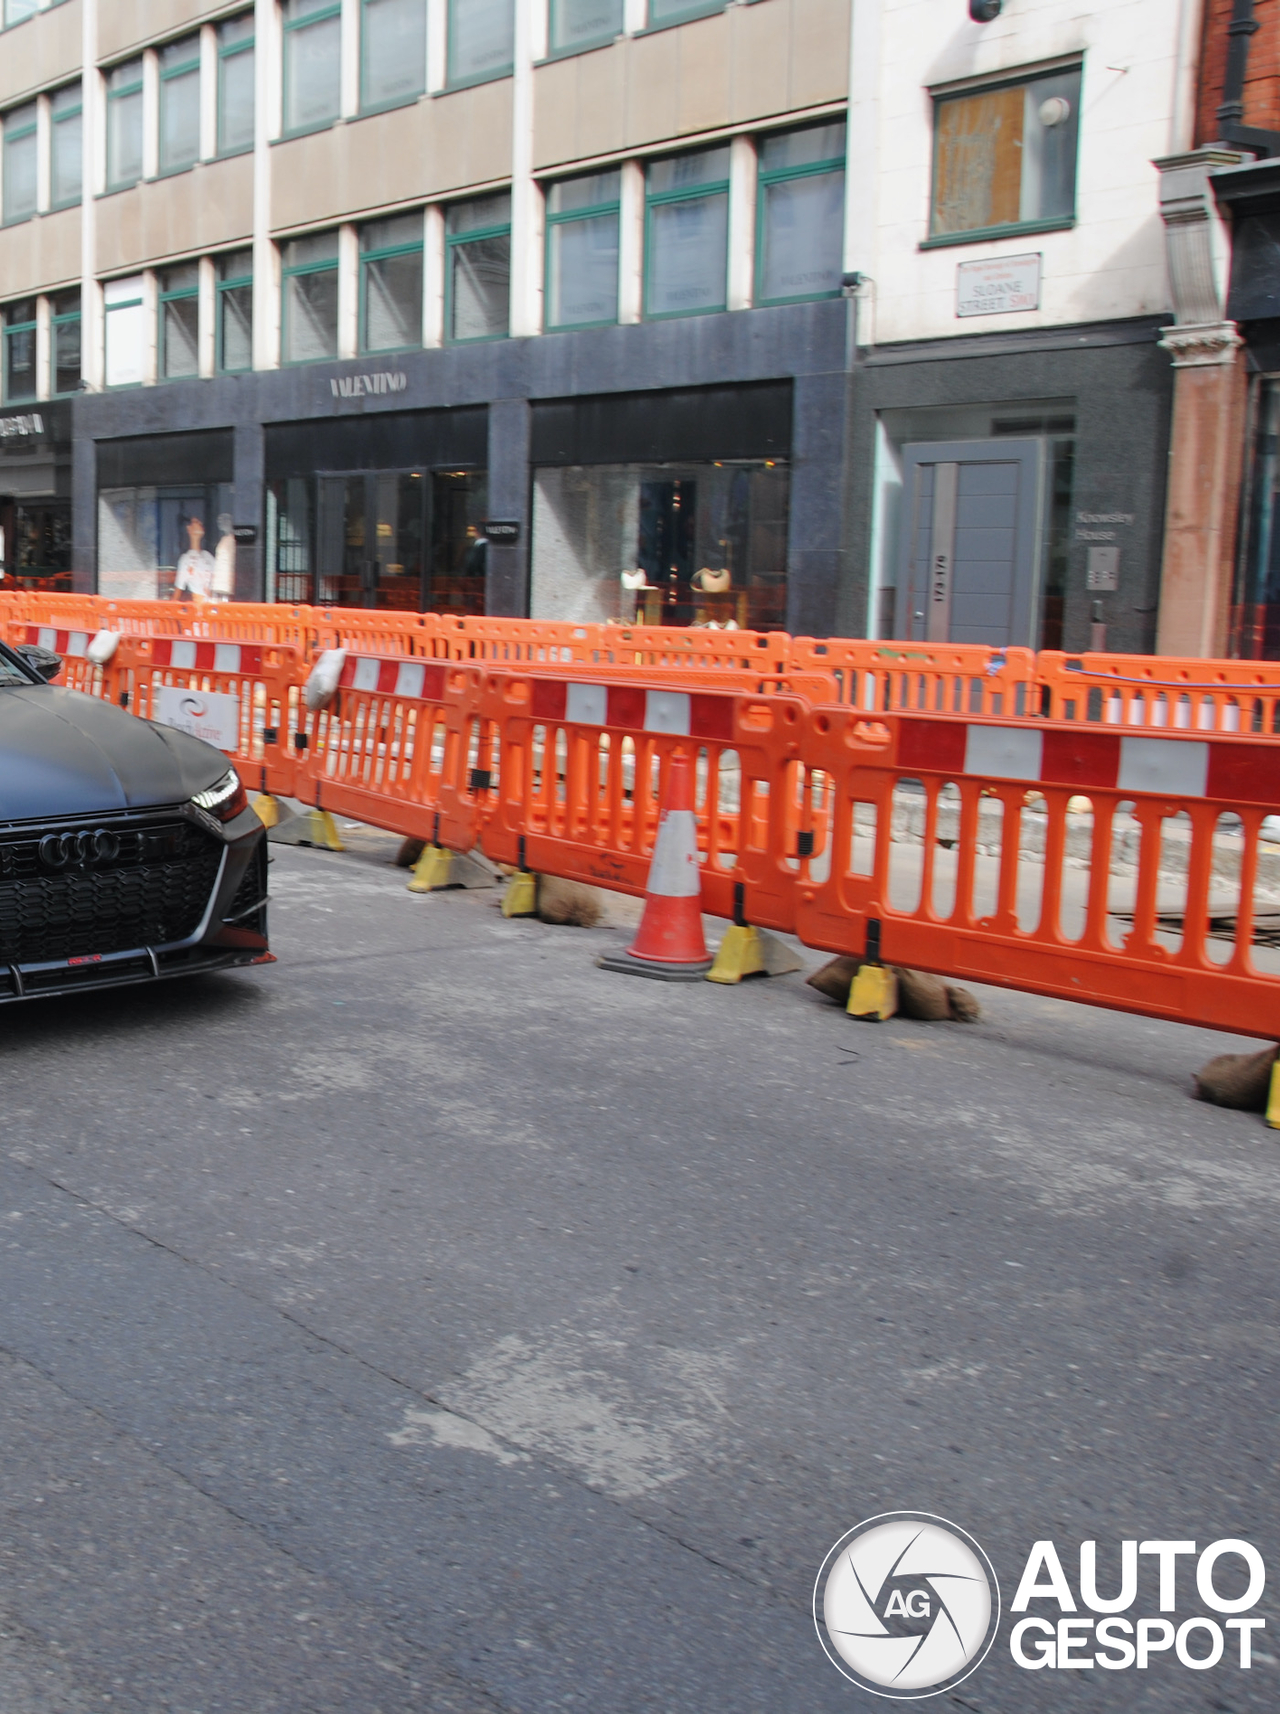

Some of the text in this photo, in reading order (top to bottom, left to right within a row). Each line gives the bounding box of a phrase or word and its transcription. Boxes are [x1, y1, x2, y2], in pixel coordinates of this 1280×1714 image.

[972, 281, 1023, 299] SLOANE
[329, 371, 407, 398] VALENTINO
[1075, 511, 1136, 526] Knowsley
[1075, 529, 1117, 541] House
